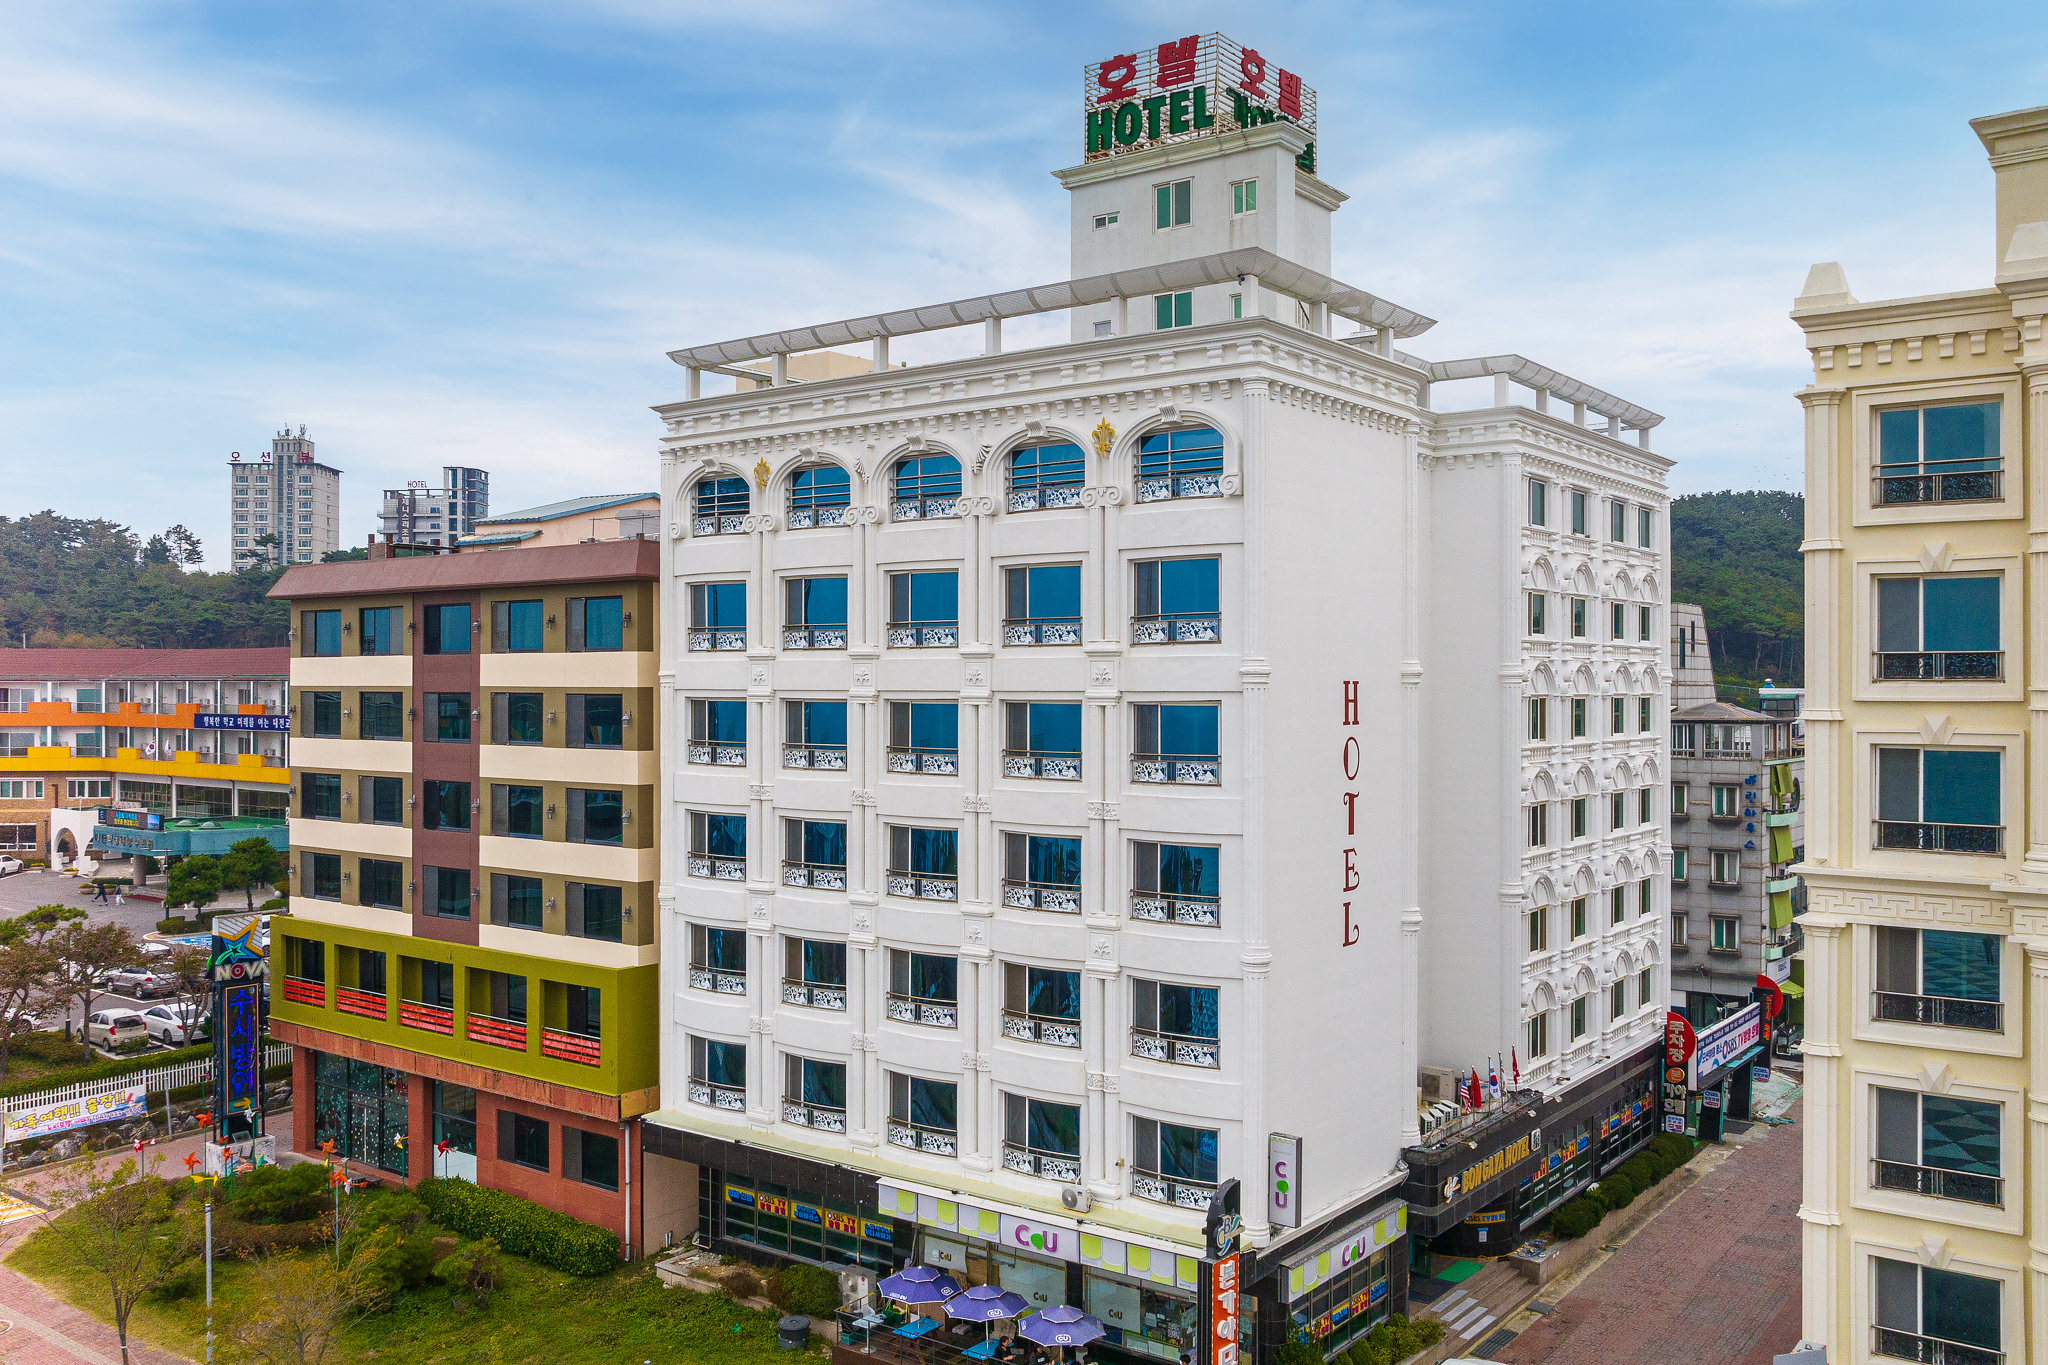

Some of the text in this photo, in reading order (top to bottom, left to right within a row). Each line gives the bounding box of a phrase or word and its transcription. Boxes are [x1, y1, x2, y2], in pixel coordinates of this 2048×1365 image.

[1097, 35, 1199, 104] 호텔
[1240, 47, 1302, 120] 호텔
[1087, 85, 1214, 153] HOTEL
[407, 480, 427, 488] HOTEL
[223, 716, 235, 727] 학교
[1342, 680, 1361, 948] HOTEL
[215, 958, 271, 982] NOVA
[1668, 1020, 1685, 1063] 주차장
[10, 1090, 127, 1131] 가족여행!! 출장!!
[1505, 1135, 1530, 1169] HOTEL
